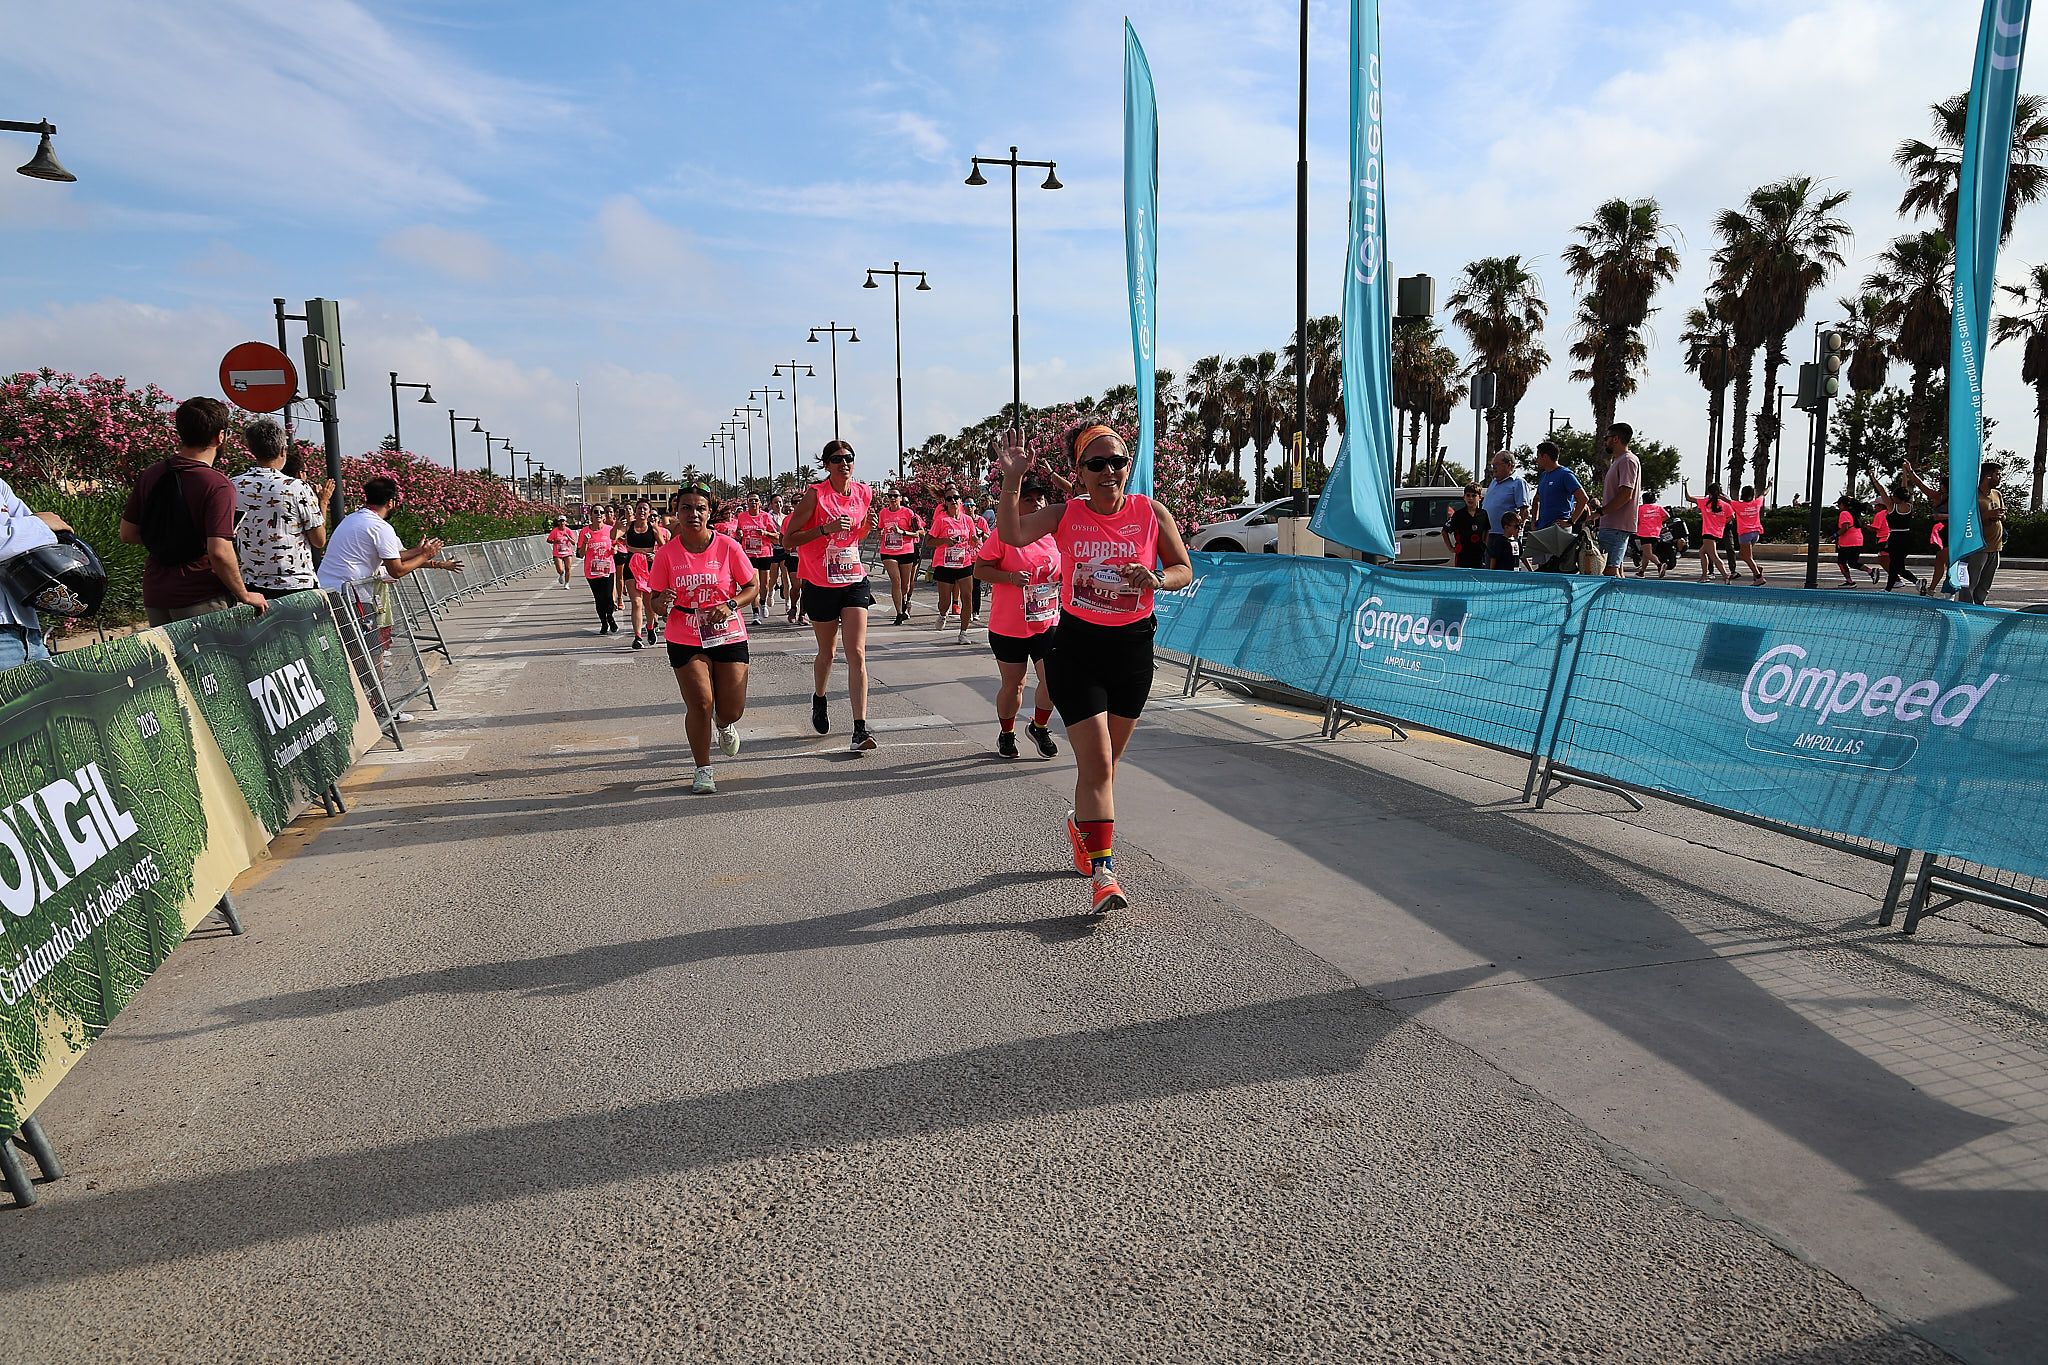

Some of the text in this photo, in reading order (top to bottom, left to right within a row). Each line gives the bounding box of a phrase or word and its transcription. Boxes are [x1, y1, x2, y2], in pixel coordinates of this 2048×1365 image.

[1953, 282, 1970, 339] sanitarios.
[1963, 339, 1981, 393] productos
[1971, 395, 1982, 408] de
[1071, 523, 1099, 532] OYSHO
[1073, 540, 1138, 558] CARRERA
[675, 573, 719, 588] CARRERA
[698, 588, 711, 604] DE
[1094, 587, 1119, 600] 016
[1355, 596, 1470, 652] Compeed
[1384, 655, 1421, 671] AMPOLLAS
[201, 672, 219, 697] 1975
[1741, 643, 2000, 727] Compeed
[136, 710, 160, 740] 2026
[1793, 732, 1864, 755] AMPOLLAS
[0, 854, 161, 1007] Cuidando de ti desde 1975
